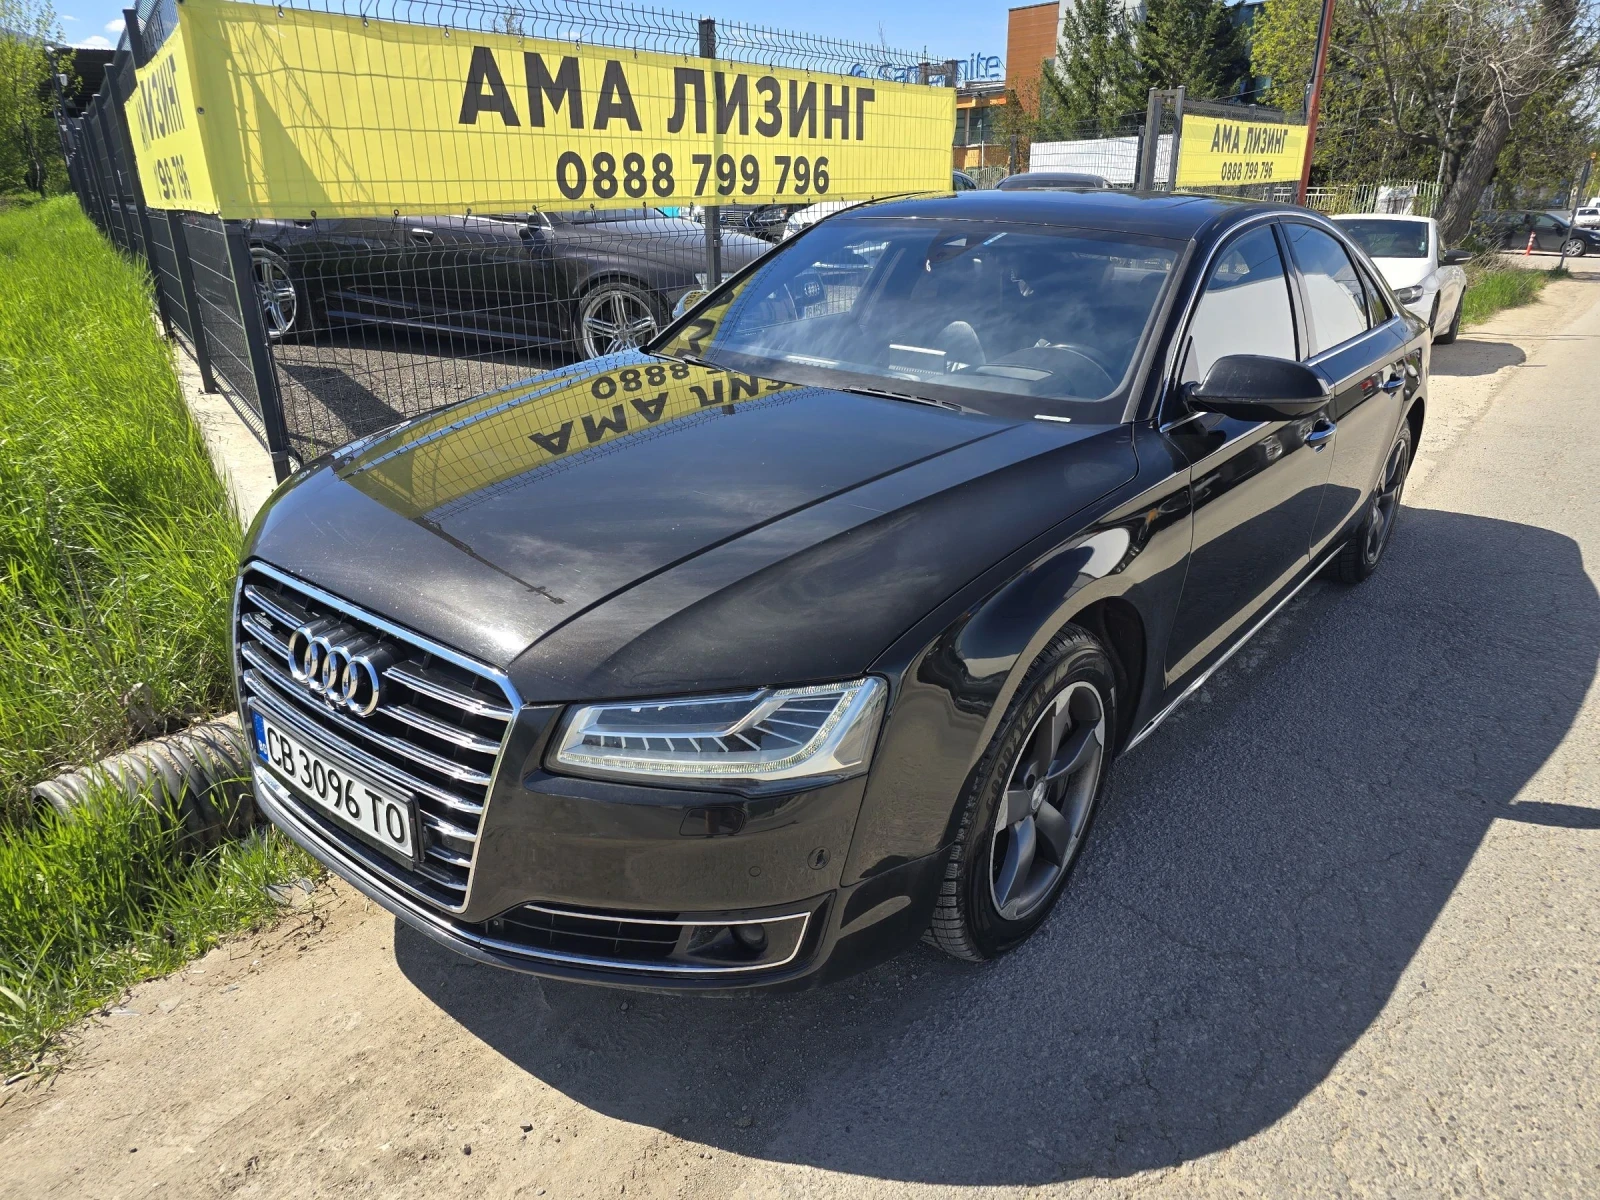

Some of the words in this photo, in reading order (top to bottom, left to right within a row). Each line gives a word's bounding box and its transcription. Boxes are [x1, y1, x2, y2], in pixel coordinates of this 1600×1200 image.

[458, 45, 643, 131] АМА
[667, 67, 876, 141] ЛИЗИНГ
[1210, 123, 1240, 154] АМА
[1243, 126, 1289, 154] ЛИЗИНГ
[555, 150, 676, 200] 0888
[691, 153, 761, 197] 799
[774, 155, 830, 195] 796
[1221, 161, 1243, 181] 0888
[1243, 161, 1259, 180] 799
[1259, 161, 1274, 179] 796
[267, 727, 295, 776] CB
[299, 749, 360, 819] 3096
